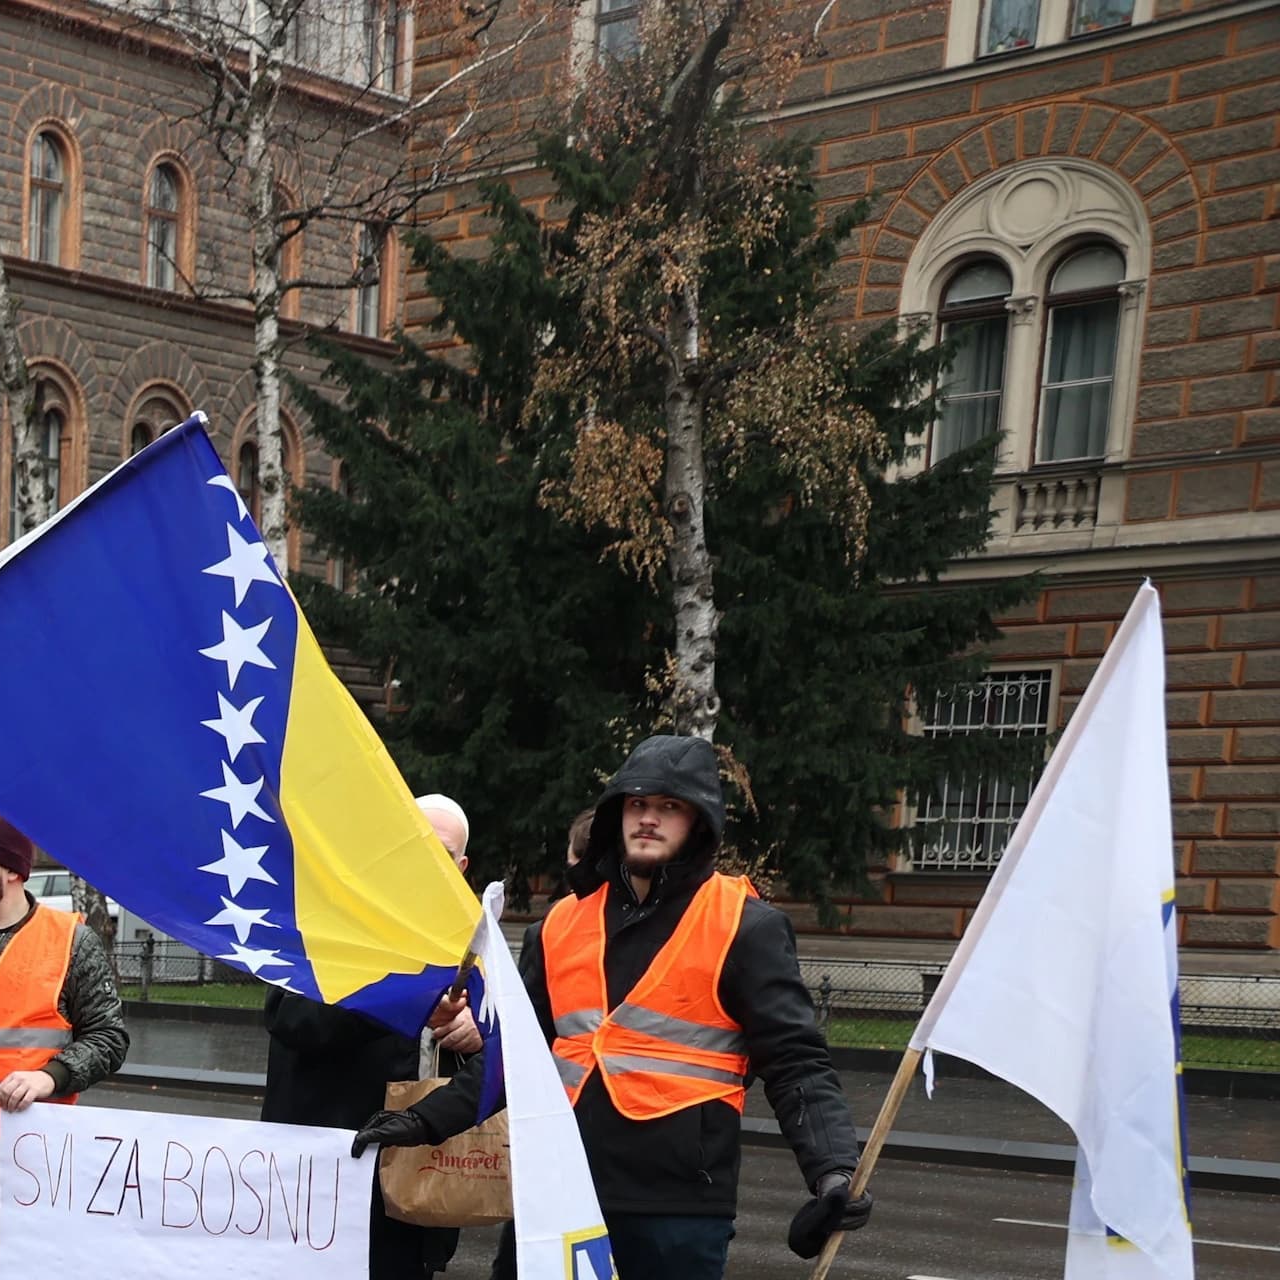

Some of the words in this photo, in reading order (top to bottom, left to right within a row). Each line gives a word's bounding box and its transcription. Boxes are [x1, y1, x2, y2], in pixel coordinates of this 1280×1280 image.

[12, 1131, 73, 1211] SVI
[85, 1135, 144, 1220] ZA
[161, 1140, 340, 1251] BOSNU
[431, 1149, 504, 1170] Imaret
